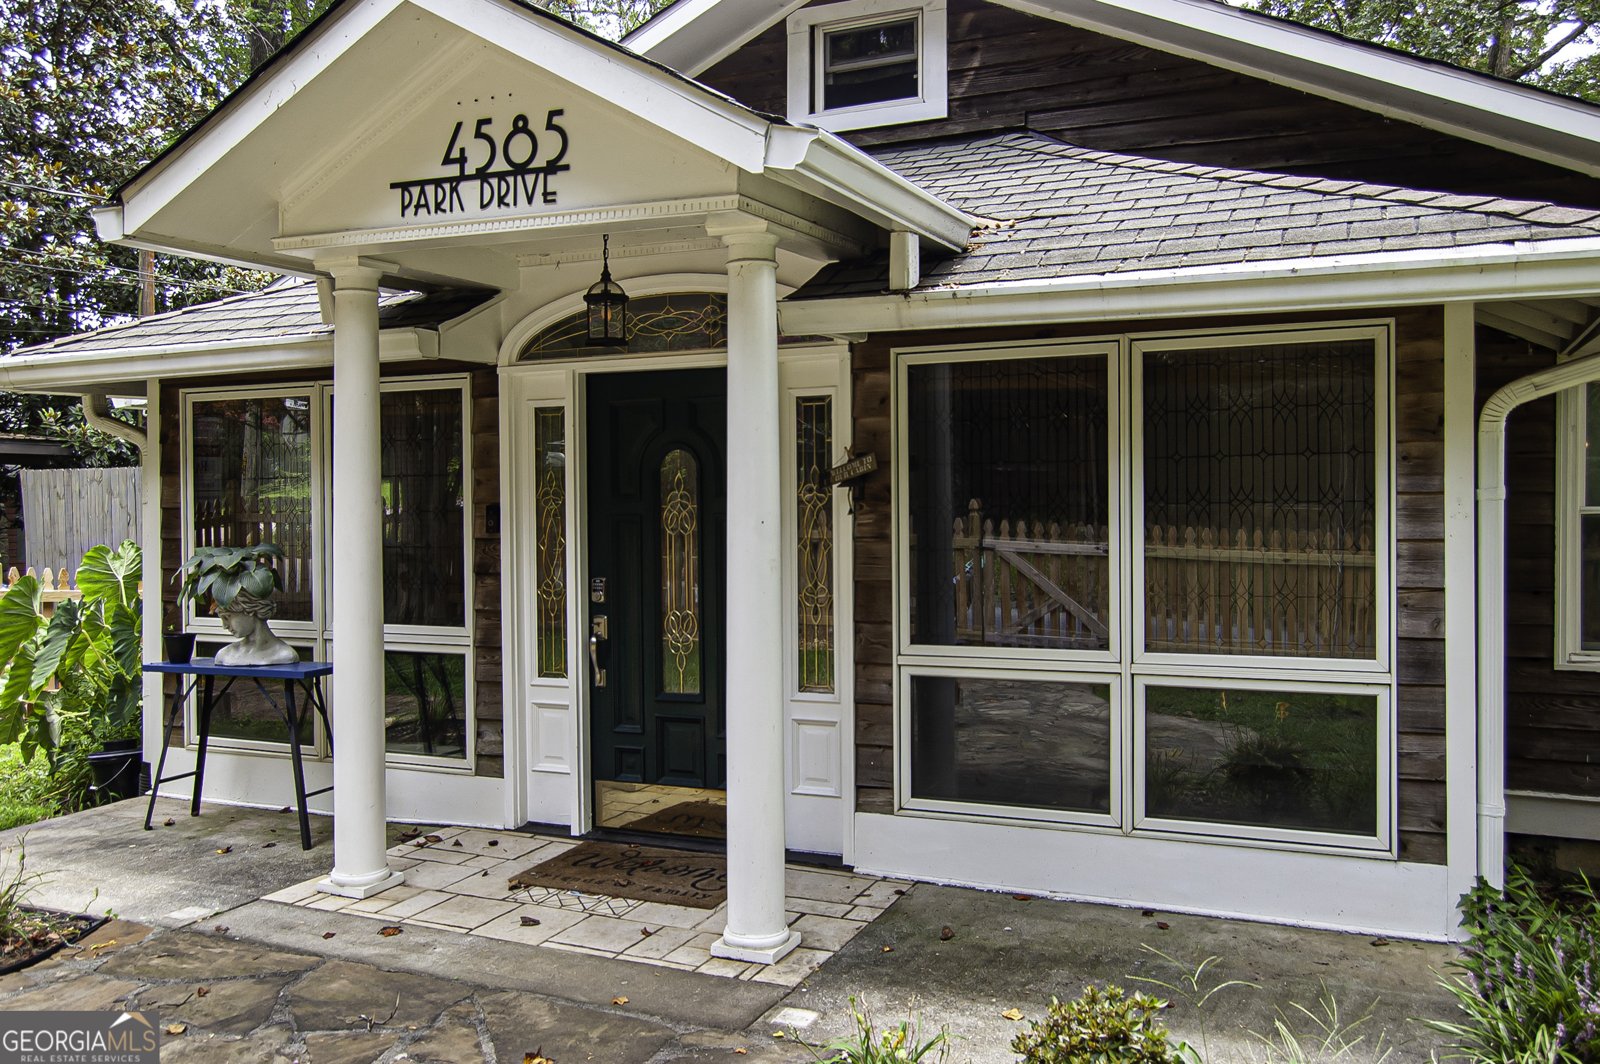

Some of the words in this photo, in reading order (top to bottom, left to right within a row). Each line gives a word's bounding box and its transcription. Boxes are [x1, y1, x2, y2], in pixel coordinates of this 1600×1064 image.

[441, 108, 569, 175] 4585
[400, 180, 465, 218] PARK
[479, 170, 558, 210] DRIVE
